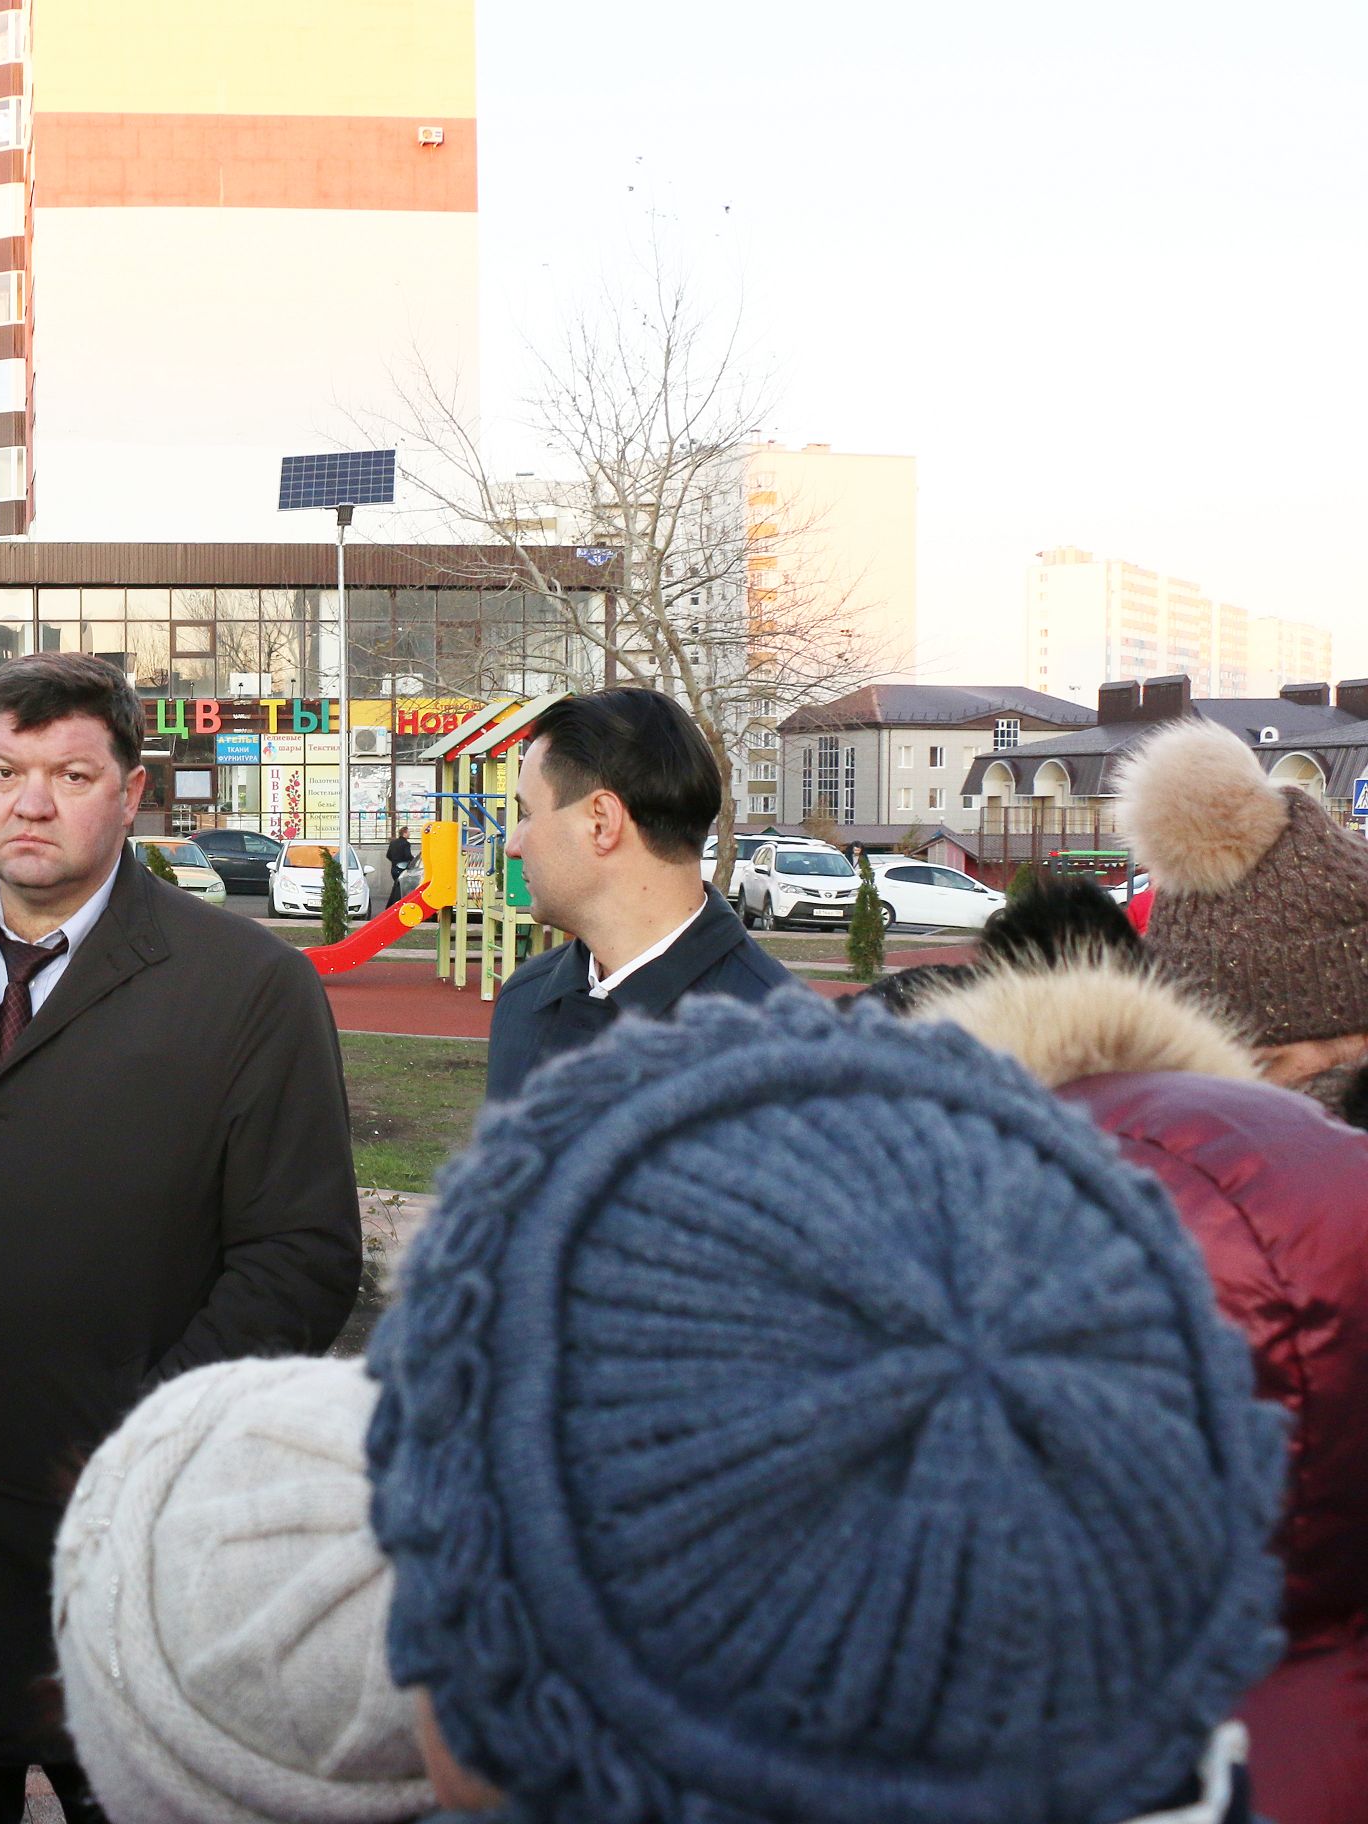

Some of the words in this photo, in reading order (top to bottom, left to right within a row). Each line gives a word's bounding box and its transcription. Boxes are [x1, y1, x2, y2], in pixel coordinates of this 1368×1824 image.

[157, 699, 330, 740] ЦВТЫ
[218, 735, 259, 744] АТЕЛЬЕ
[278, 744, 302, 752] шары
[308, 744, 341, 752] Текстил
[270, 769, 282, 828] ЦВЕТЫ
